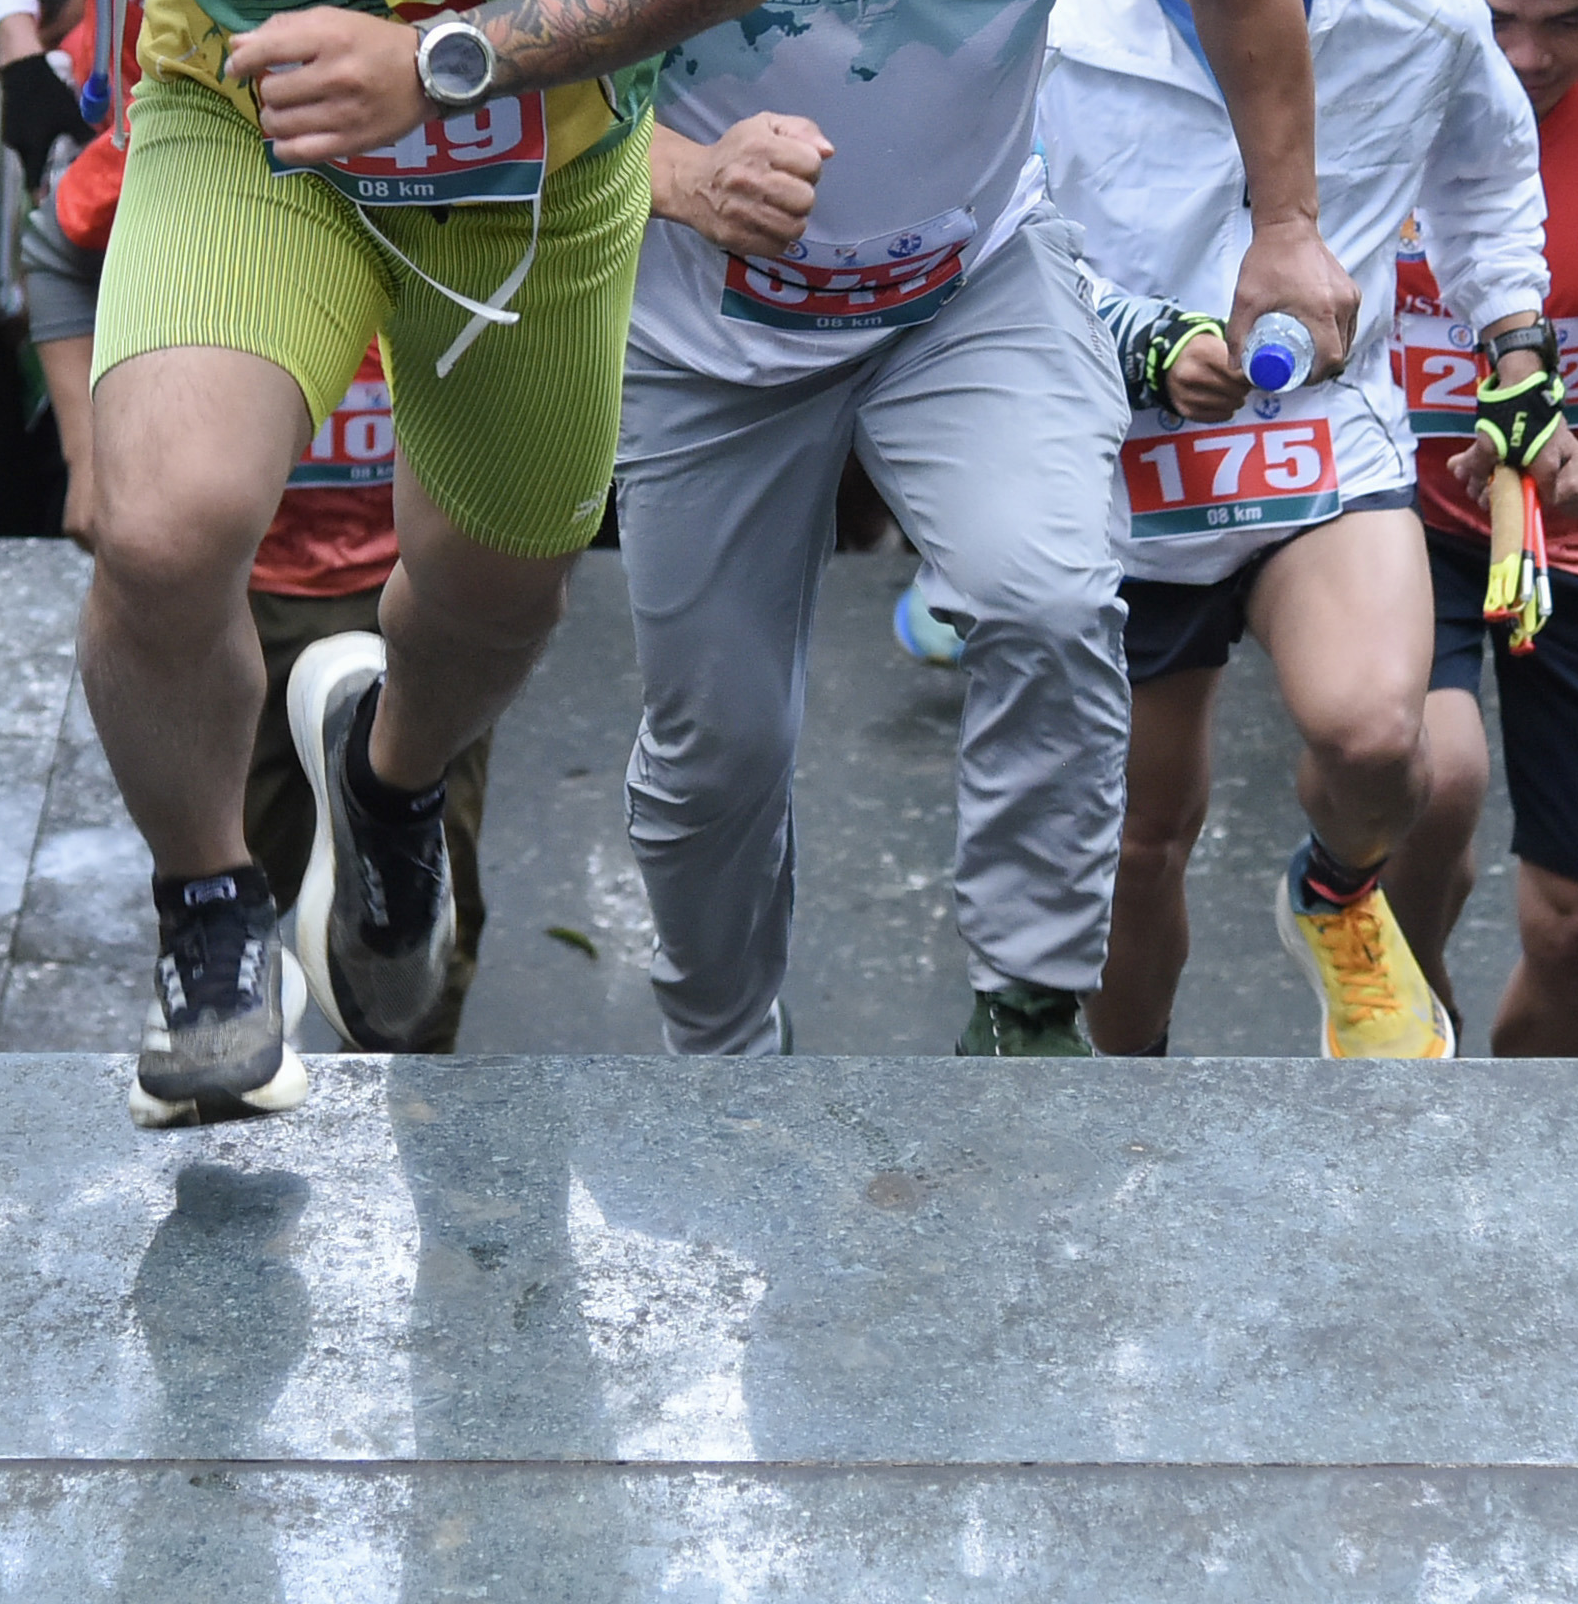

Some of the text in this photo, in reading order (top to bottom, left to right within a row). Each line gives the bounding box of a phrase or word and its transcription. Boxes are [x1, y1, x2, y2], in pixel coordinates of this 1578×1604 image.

[358, 180, 435, 197] 08 km
[817, 315, 883, 329] 08 km
[1139, 427, 1322, 503] 175
[1207, 504, 1263, 526] 08 km
